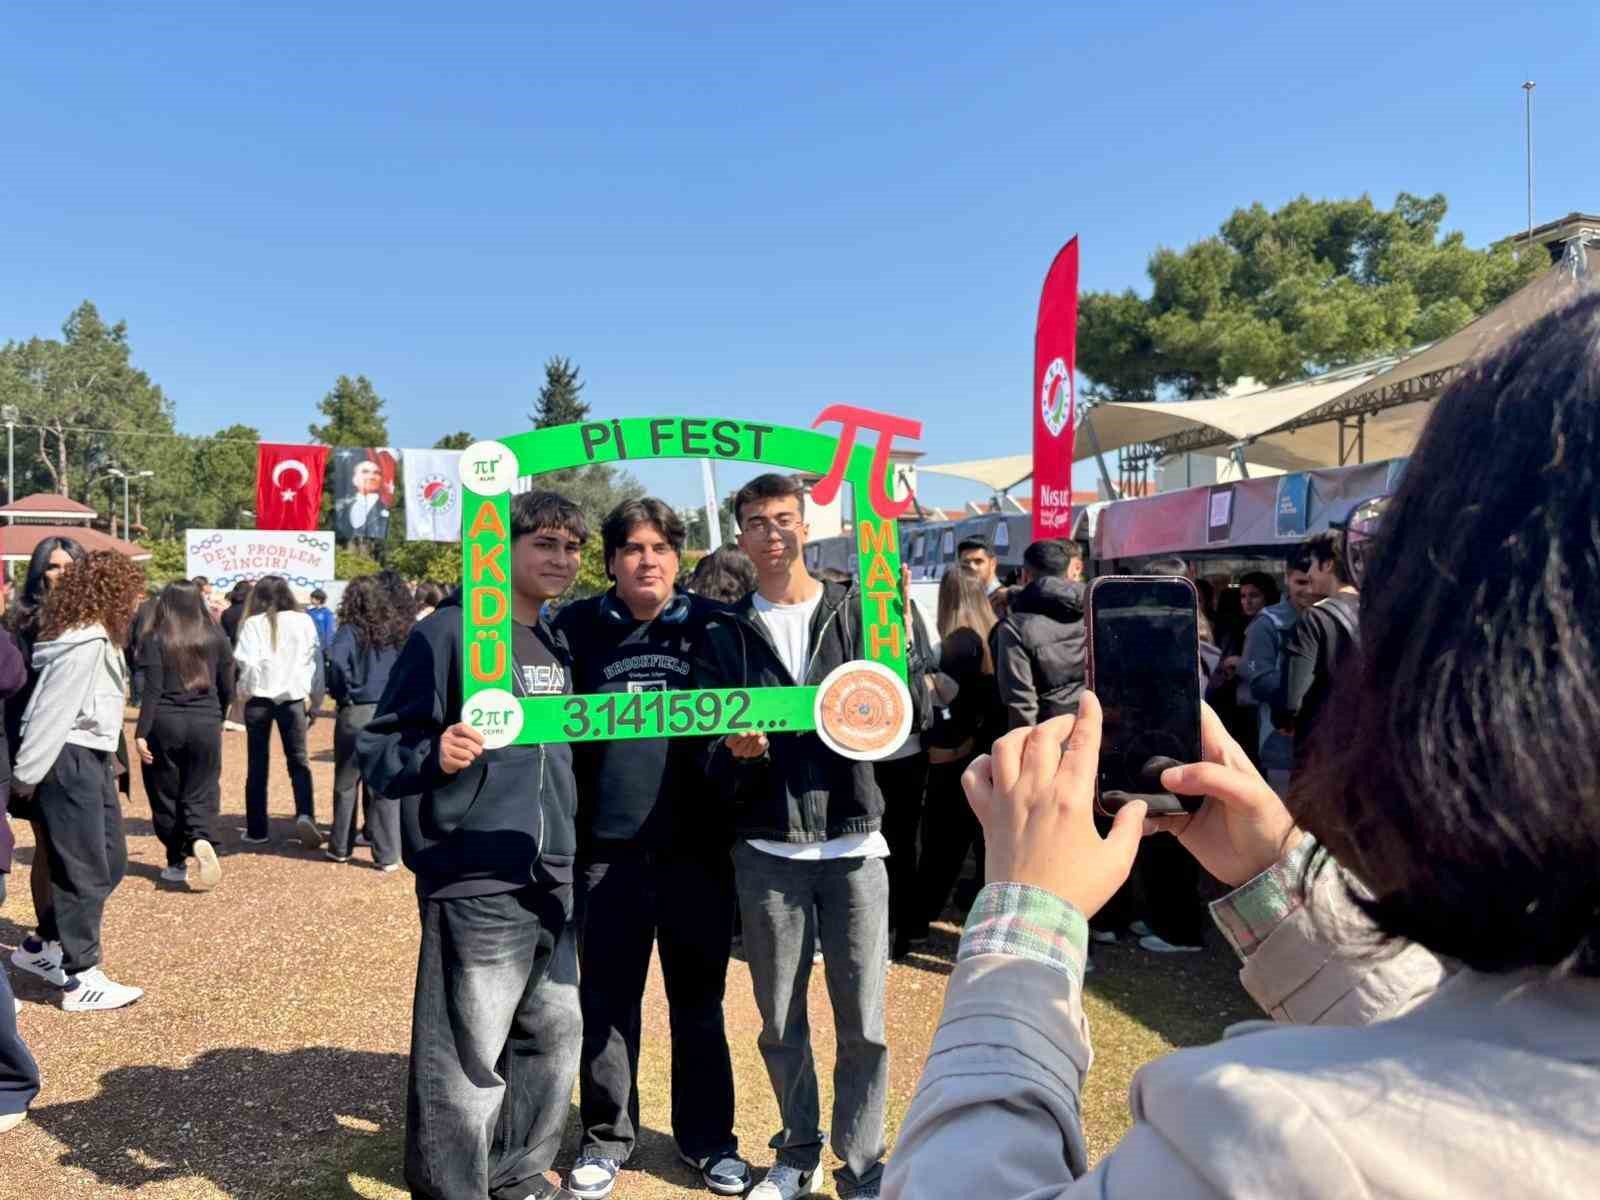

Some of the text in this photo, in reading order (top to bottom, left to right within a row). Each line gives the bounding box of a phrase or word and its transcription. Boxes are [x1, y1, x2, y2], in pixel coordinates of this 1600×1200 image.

[650, 418, 774, 460] FEST
[202, 543, 323, 567] DEV PROBLEM
[469, 501, 507, 682] AKDÜ
[859, 520, 901, 659] MATH
[471, 708, 515, 727] 2πr
[562, 690, 788, 738] 3.141592...
